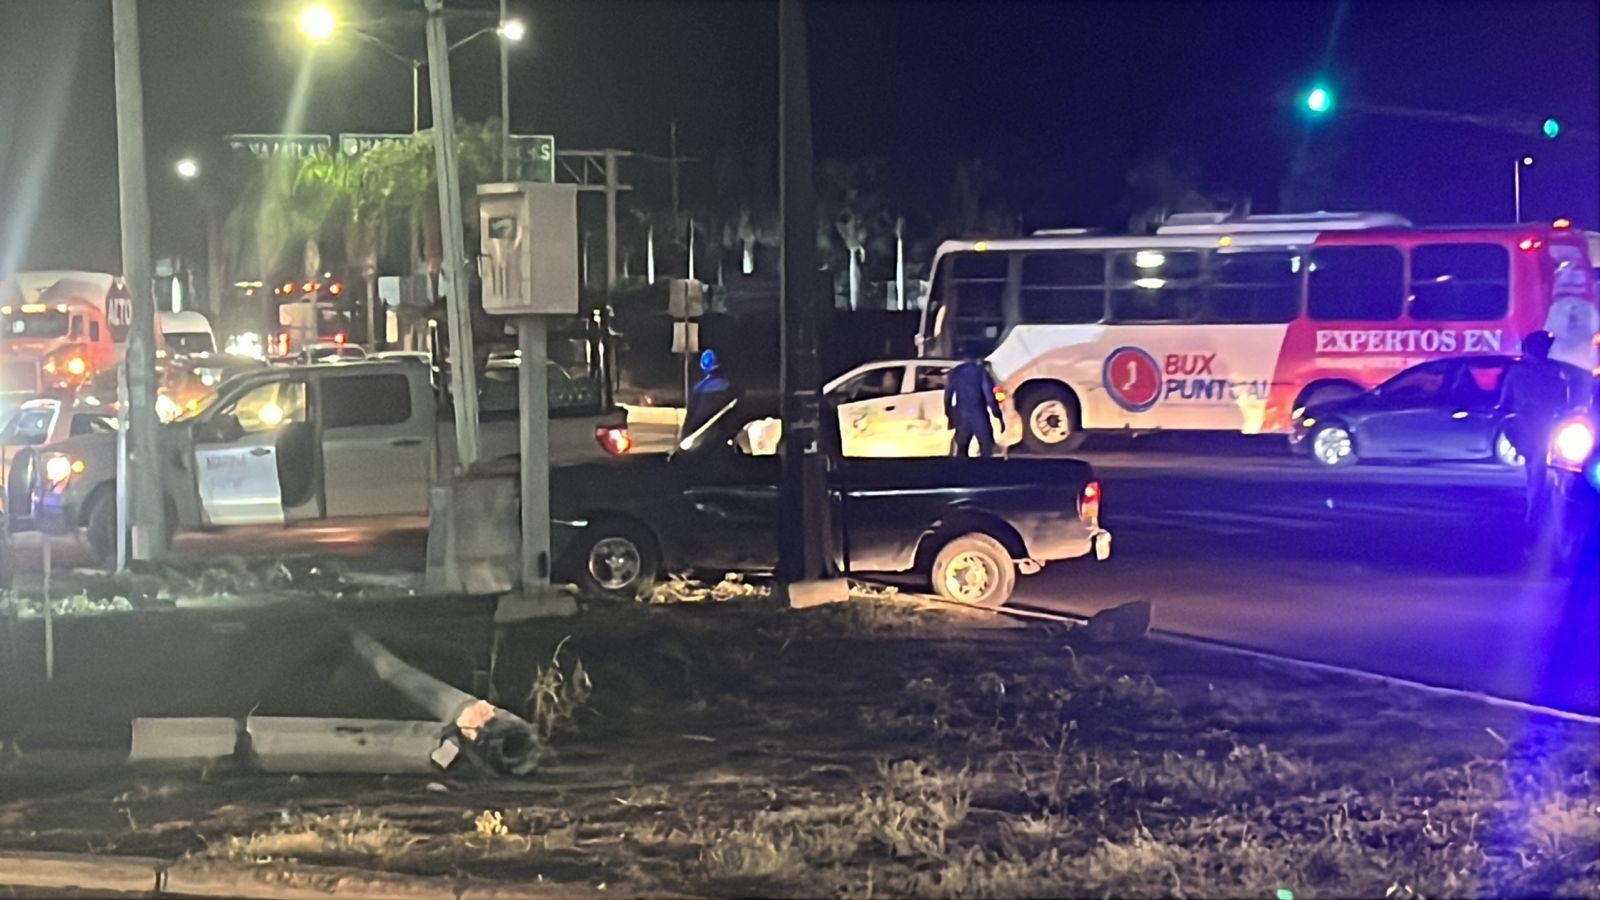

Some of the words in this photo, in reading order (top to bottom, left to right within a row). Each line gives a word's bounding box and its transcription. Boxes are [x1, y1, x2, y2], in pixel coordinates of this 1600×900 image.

[108, 298, 132, 326] ALTO
[1315, 329, 1457, 353] EXPERTOS
[1462, 329, 1502, 352] EN
[1165, 353, 1217, 375] BUX
